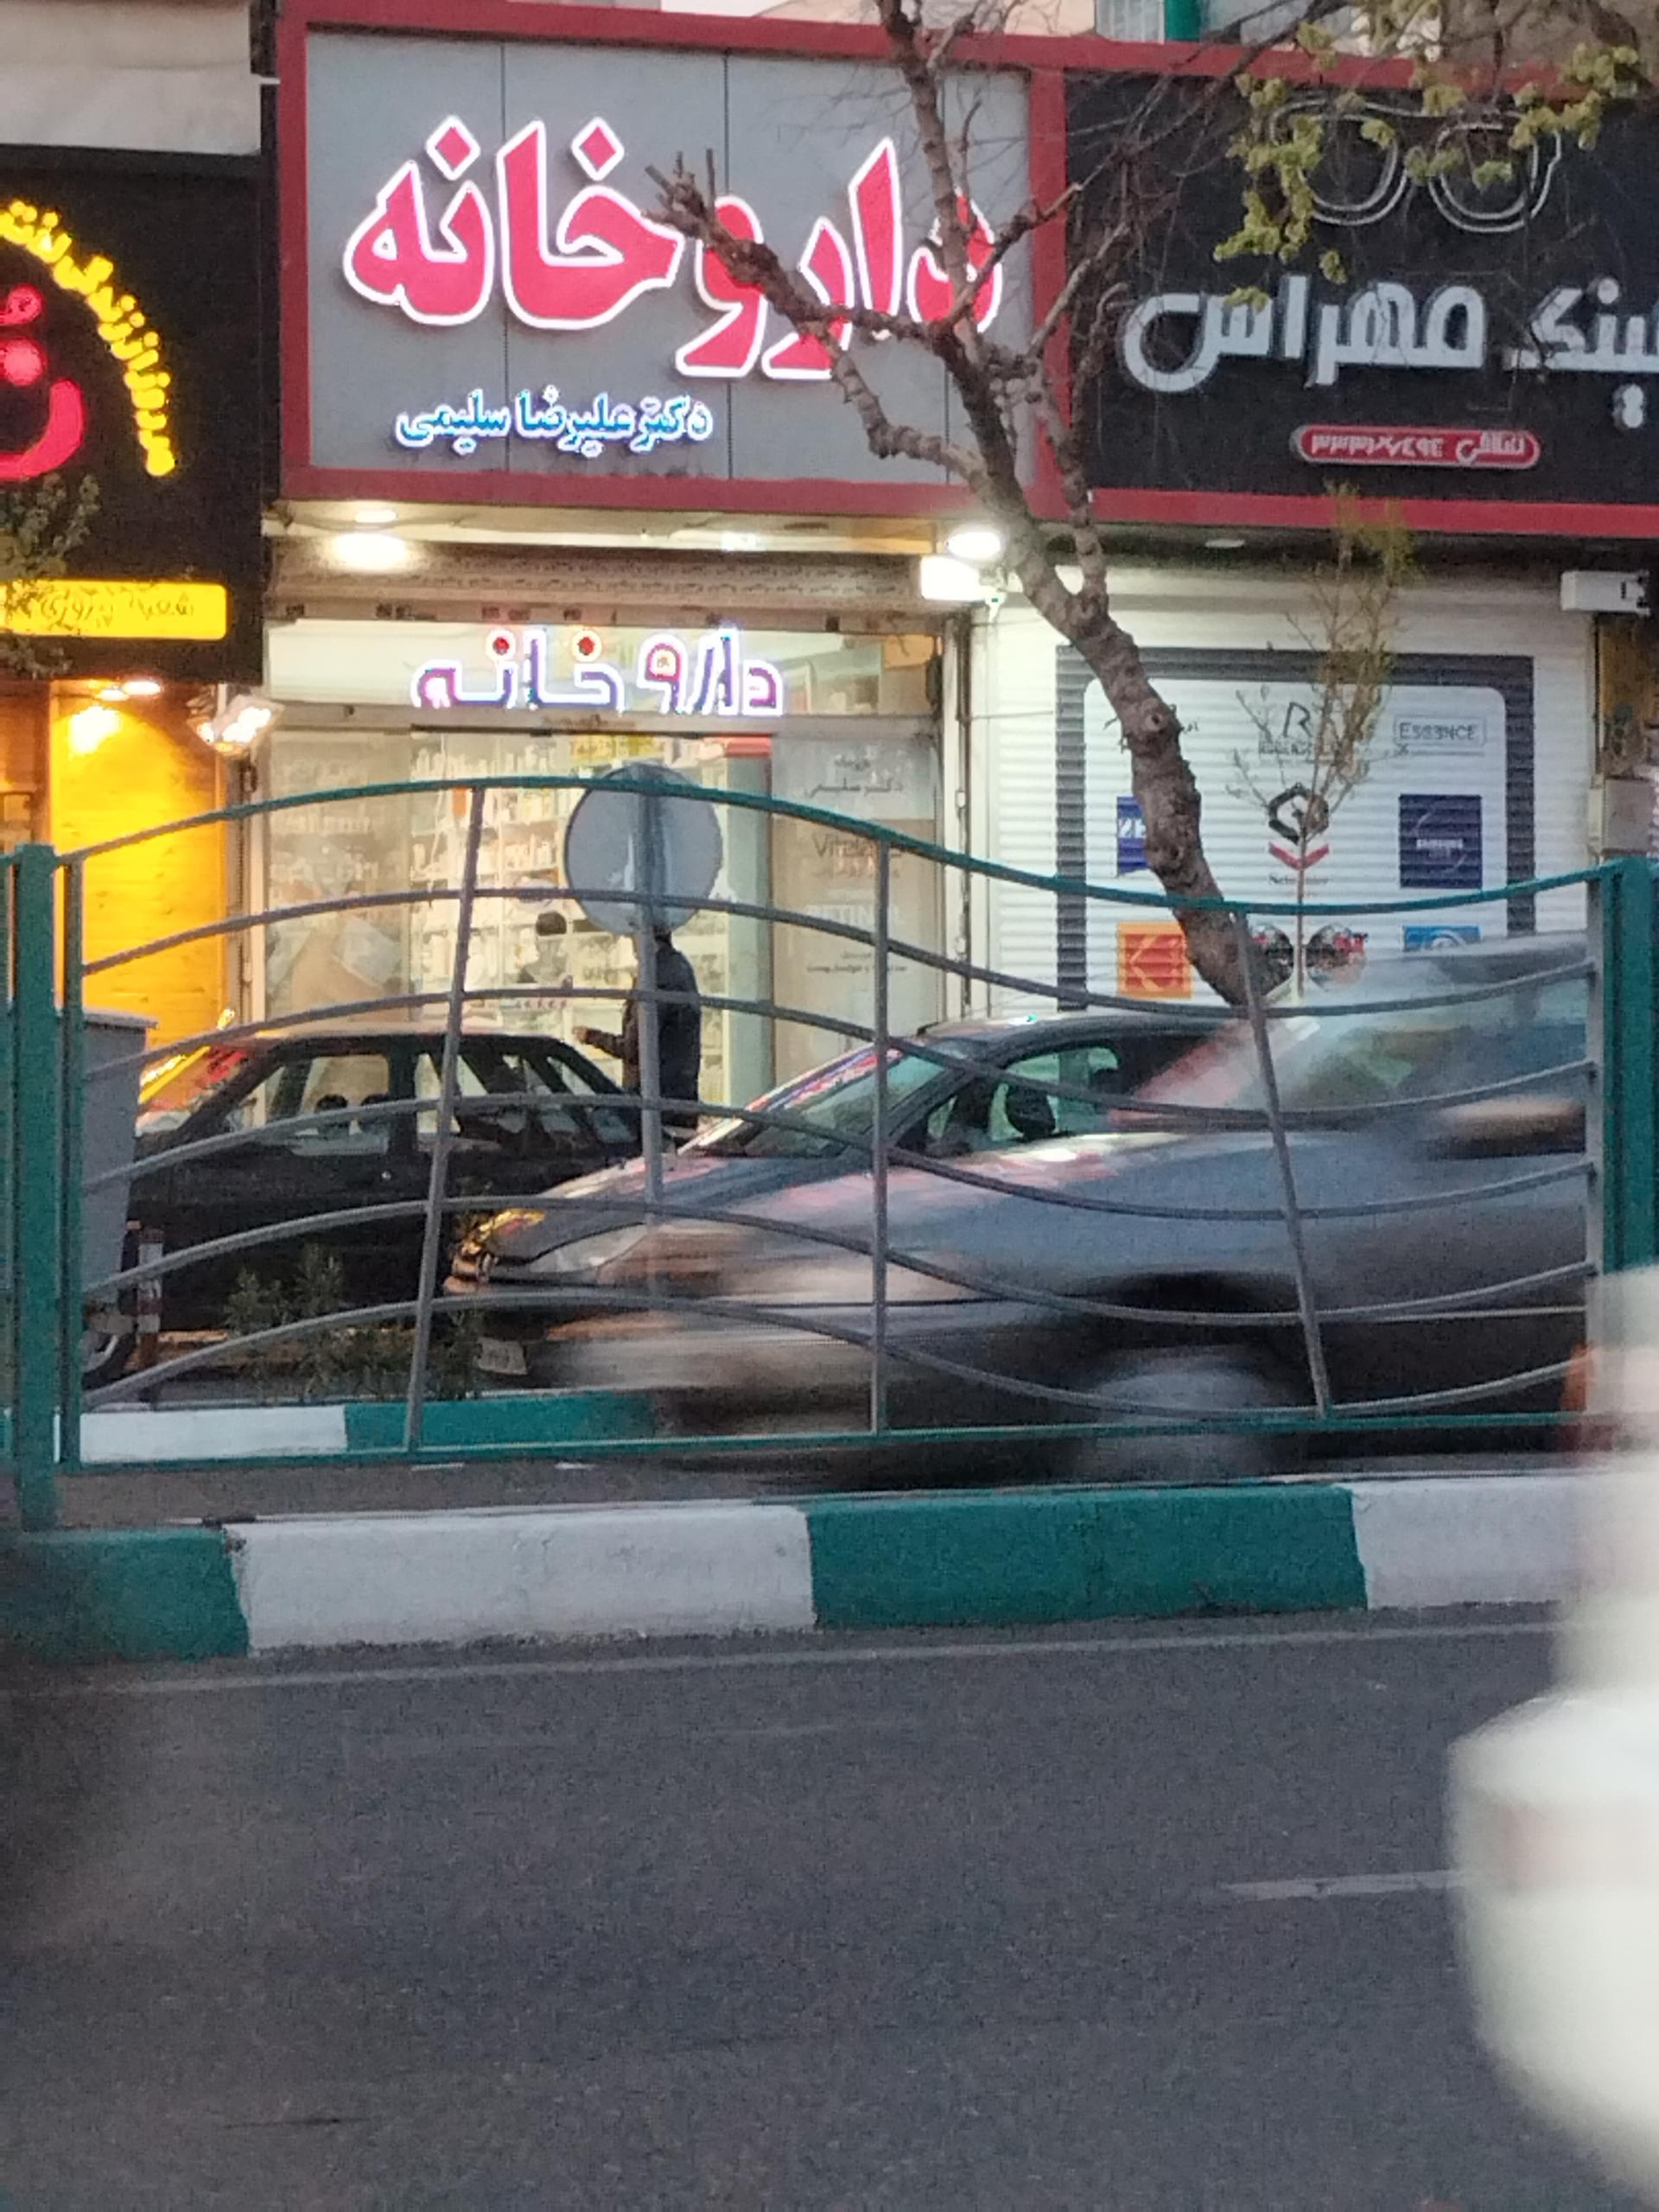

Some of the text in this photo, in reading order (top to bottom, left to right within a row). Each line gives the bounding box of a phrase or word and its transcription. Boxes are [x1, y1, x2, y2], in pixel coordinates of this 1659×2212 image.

[344, 115, 1002, 378] داروخانه
[396, 384, 713, 457] دکتر علیرضا سلیمی
